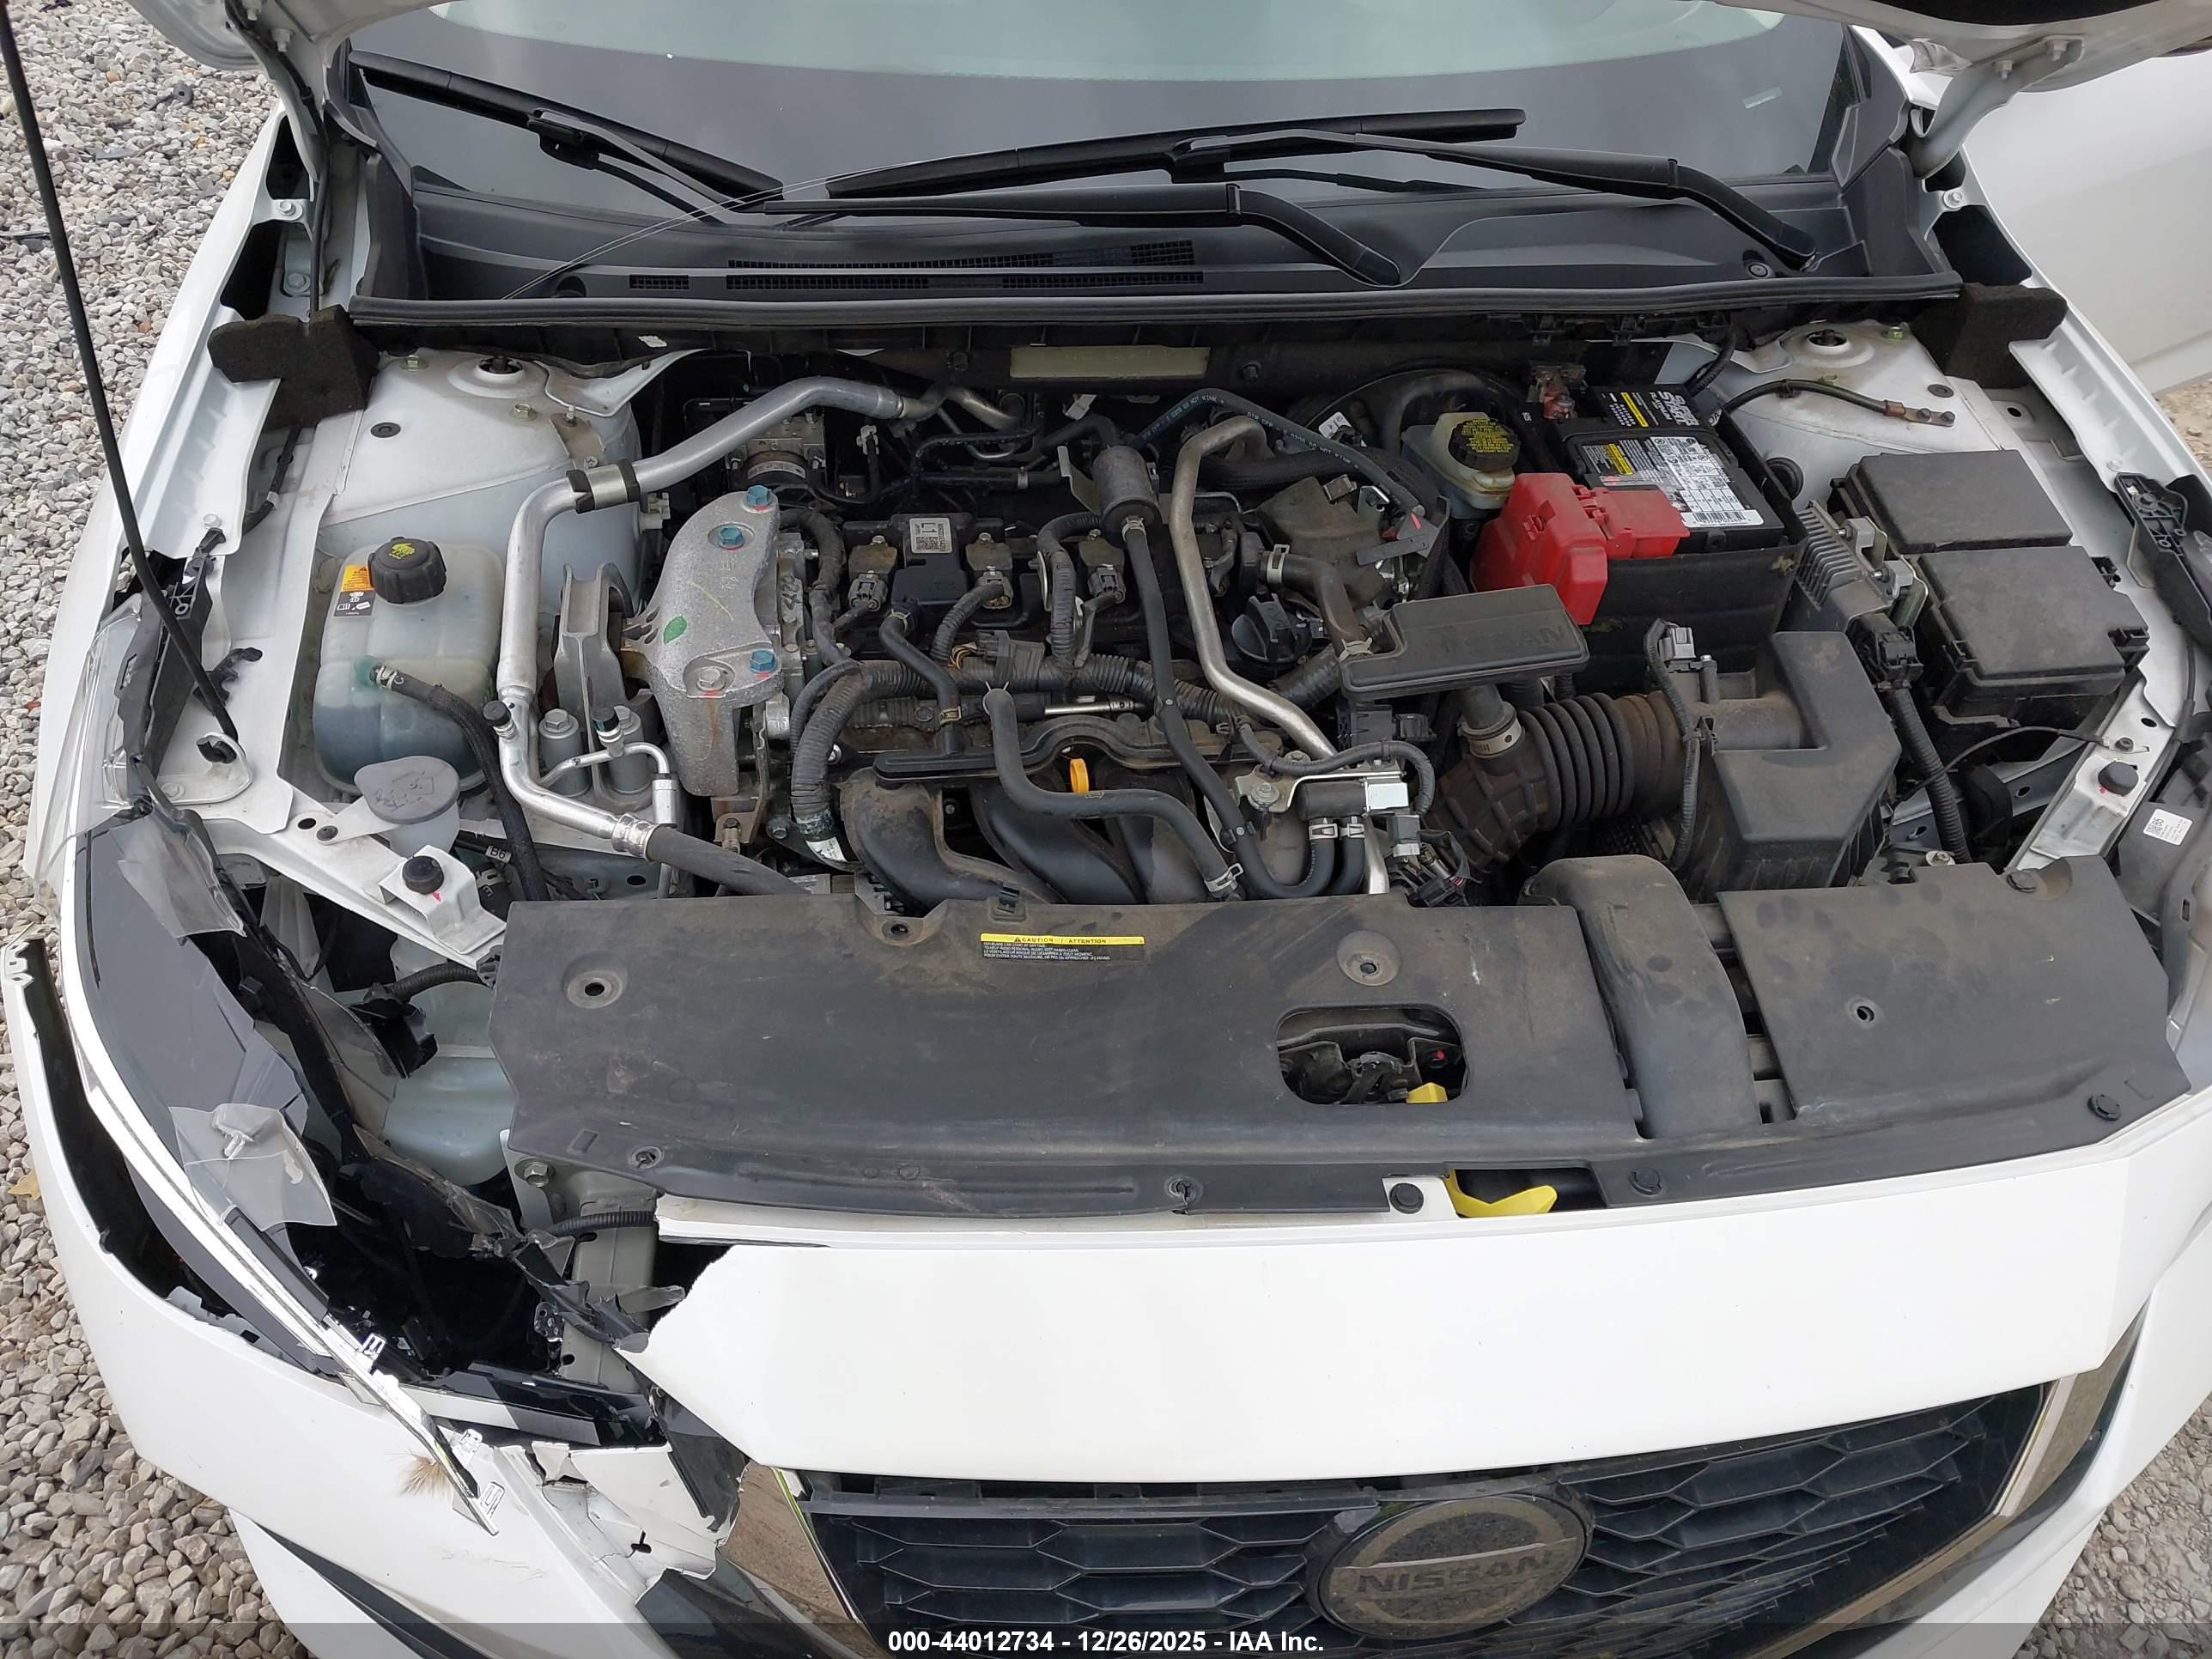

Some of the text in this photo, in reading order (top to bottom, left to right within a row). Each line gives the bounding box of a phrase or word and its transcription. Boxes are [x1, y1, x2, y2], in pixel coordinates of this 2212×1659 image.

[1656, 390, 1689, 426] START
[921, 522, 938, 533] L1
[1357, 1549, 1551, 1593] NISSAN
